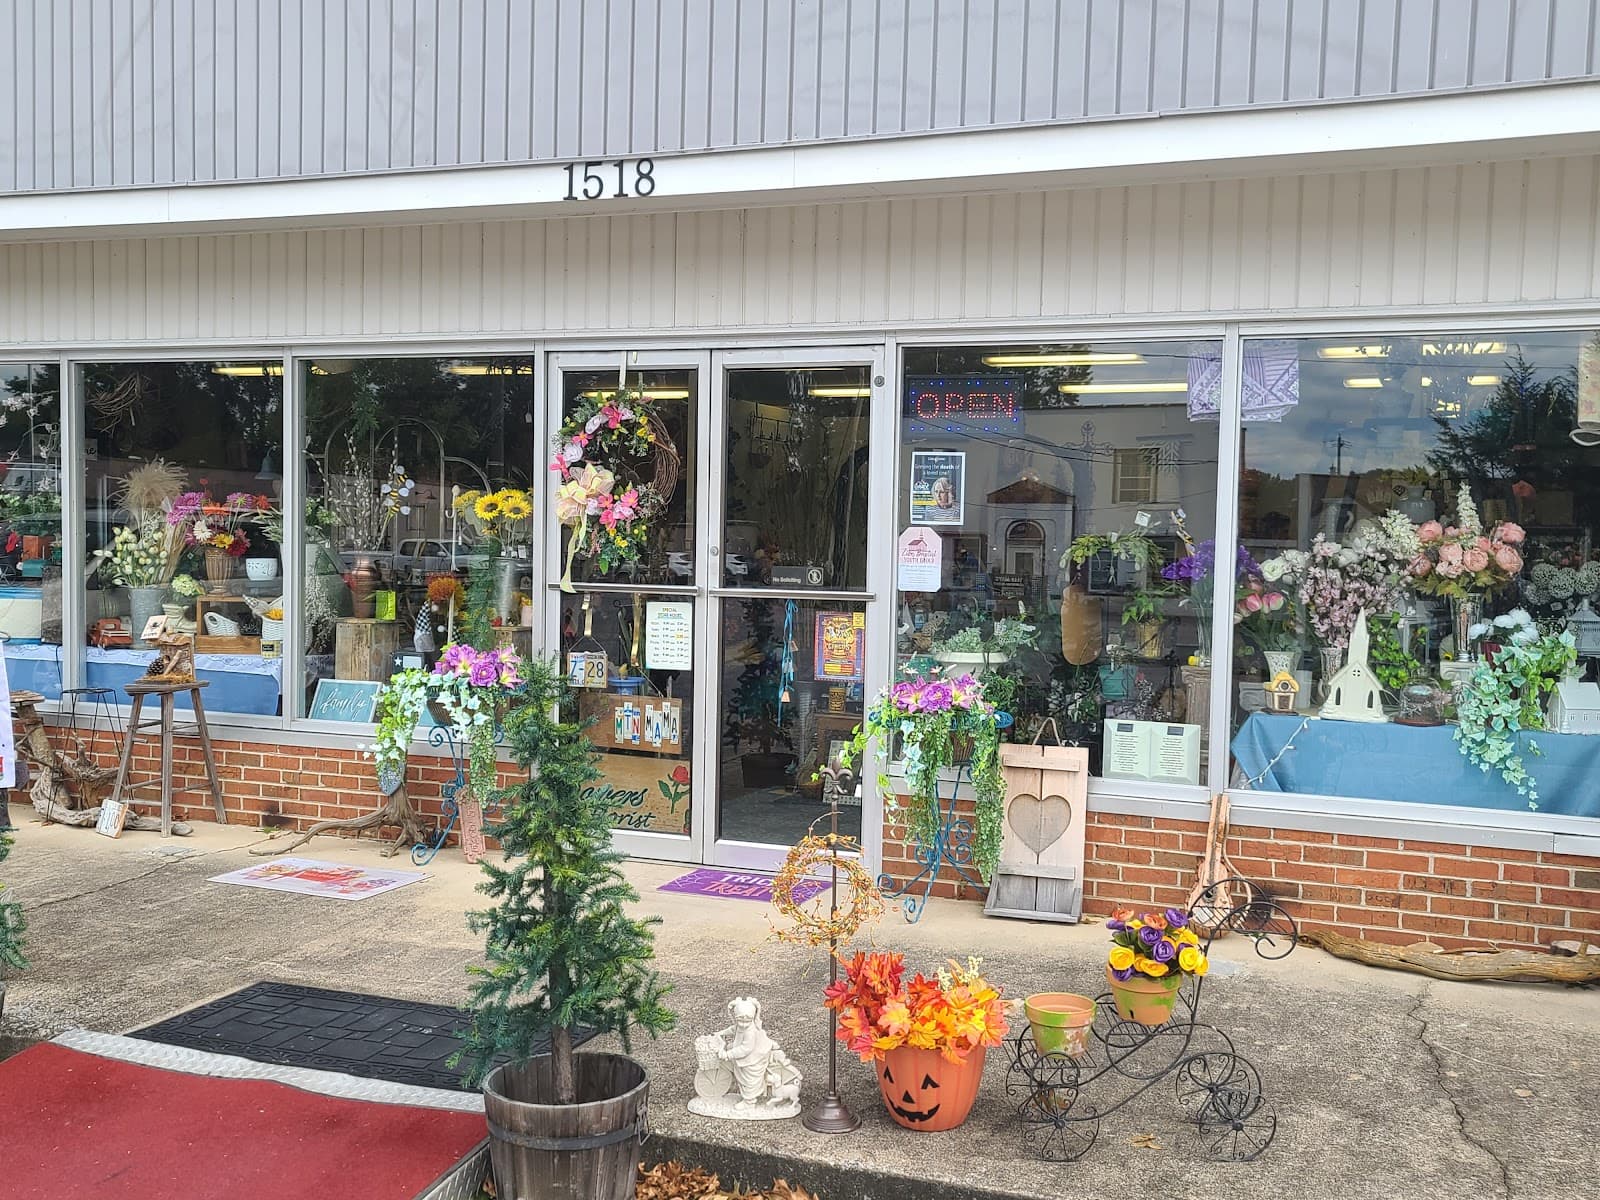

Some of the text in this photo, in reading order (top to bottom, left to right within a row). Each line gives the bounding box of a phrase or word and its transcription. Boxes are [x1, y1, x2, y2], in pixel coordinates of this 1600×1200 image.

[563, 158, 655, 200] 1518
[917, 393, 1013, 418] OPEN
[320, 687, 367, 721] family
[616, 711, 678, 739] MTN MAMA
[702, 881, 769, 897] TREAT
[720, 873, 774, 886] TRIC
